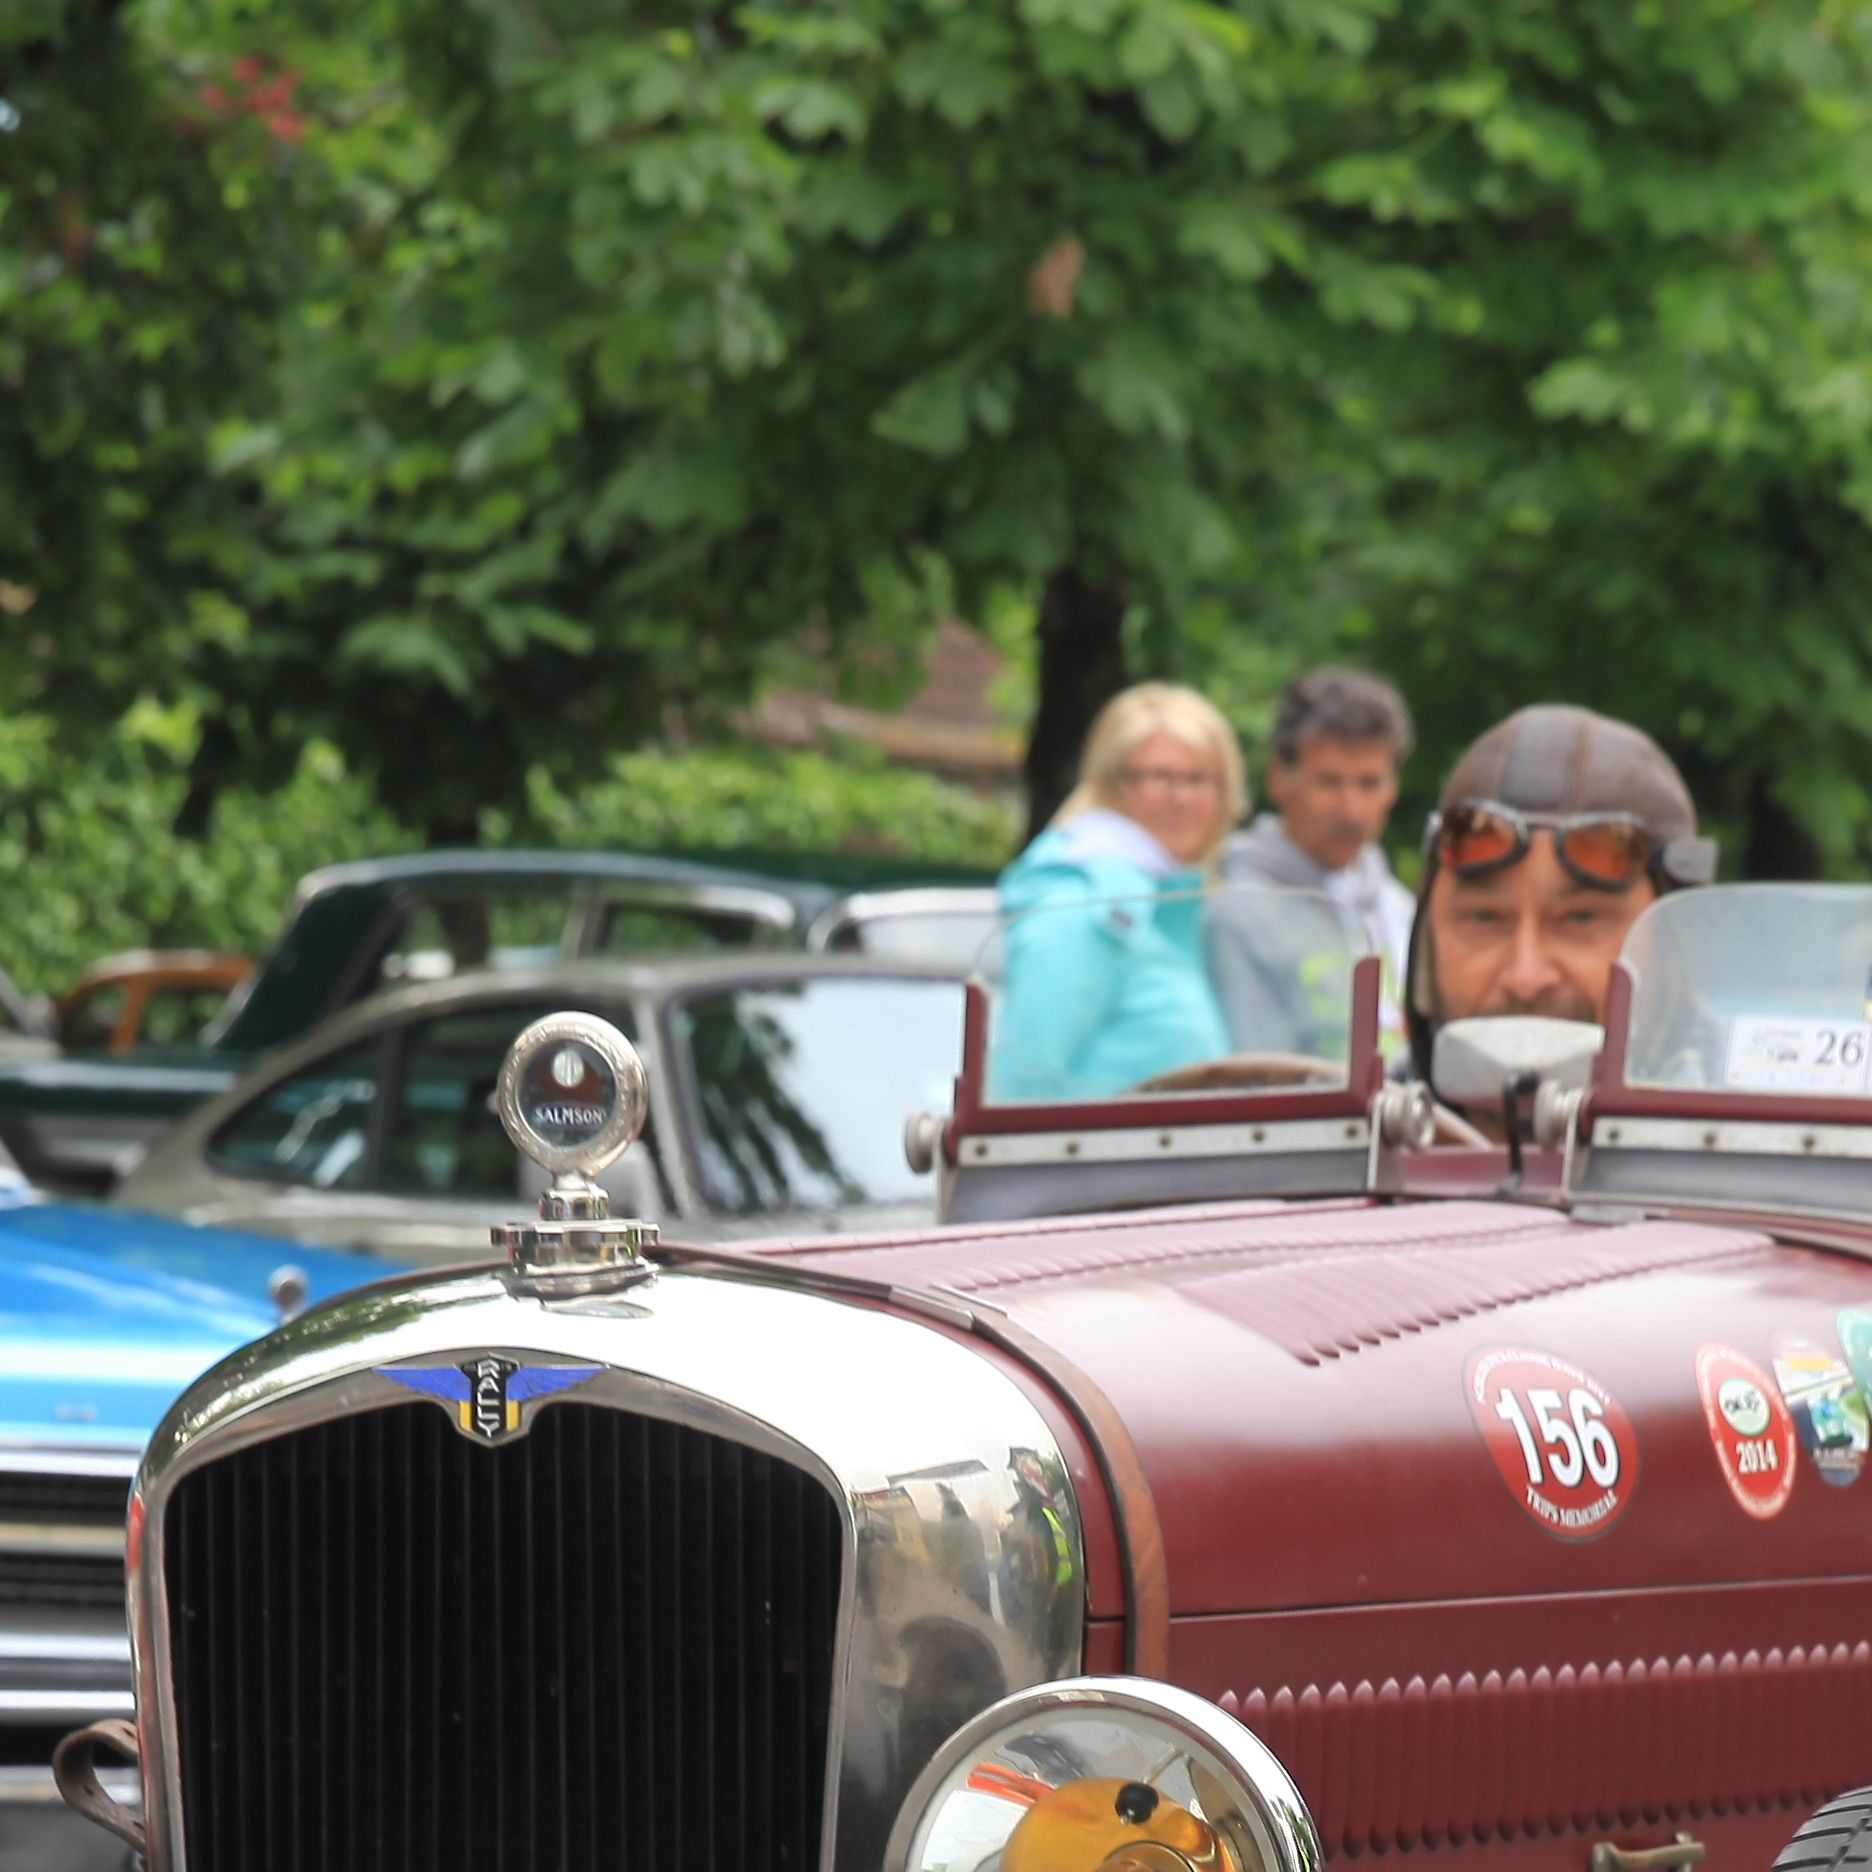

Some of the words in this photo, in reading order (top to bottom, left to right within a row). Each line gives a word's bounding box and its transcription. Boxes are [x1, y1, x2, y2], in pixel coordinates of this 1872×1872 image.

[1816, 1030, 1864, 1066] 26
[534, 1105, 604, 1126] SALMSON
[478, 1358, 501, 1439] RALLY
[1495, 1386, 1620, 1488] 156
[1735, 1438, 1778, 1474] 2014
